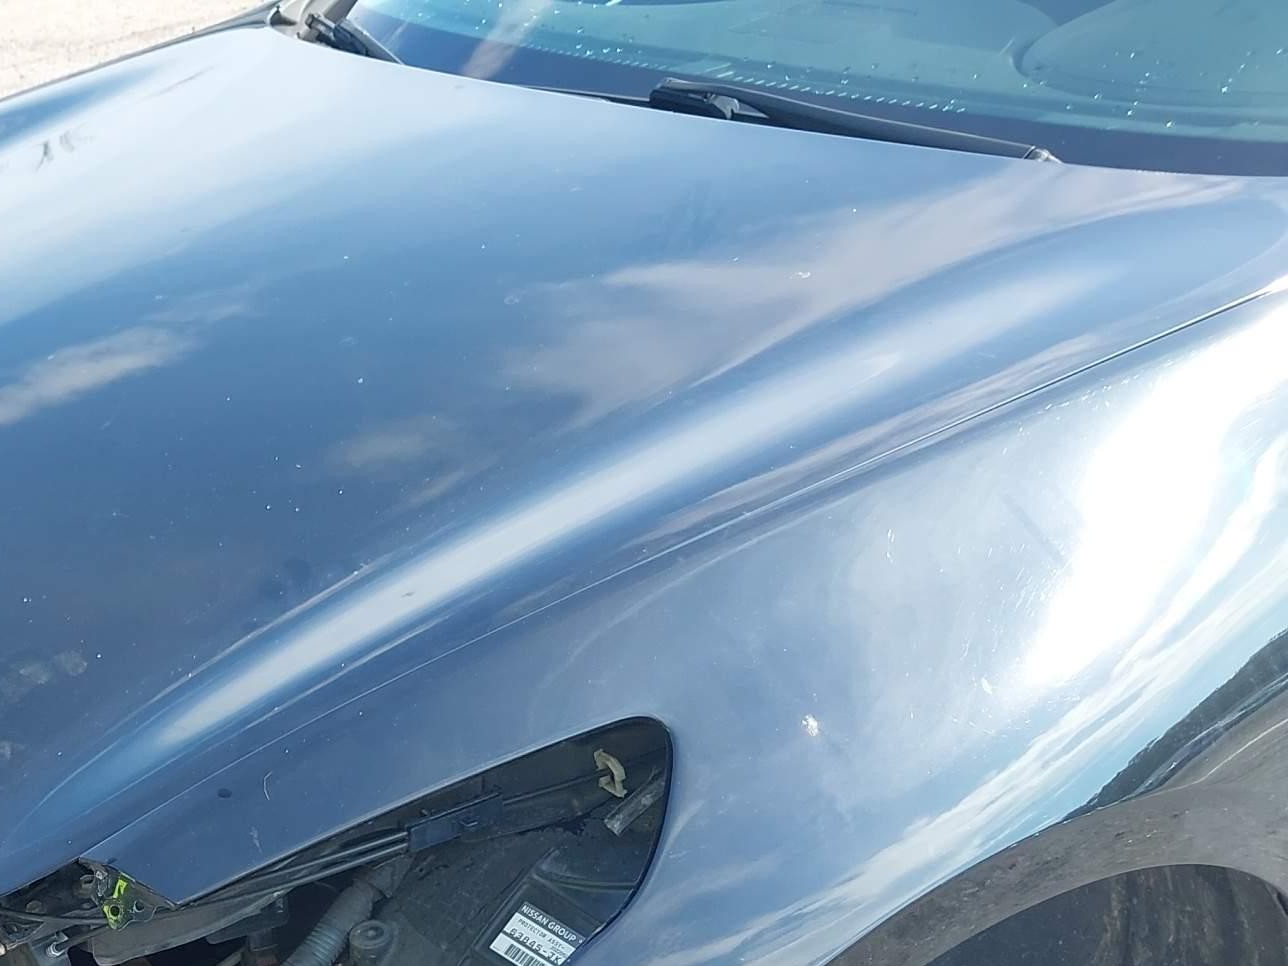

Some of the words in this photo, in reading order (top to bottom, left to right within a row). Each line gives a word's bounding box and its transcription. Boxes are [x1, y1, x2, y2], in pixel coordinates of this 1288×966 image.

[518, 918, 547, 938] PROTECTOR
[521, 904, 549, 925] NISSAN
[548, 921, 576, 941] GROUP
